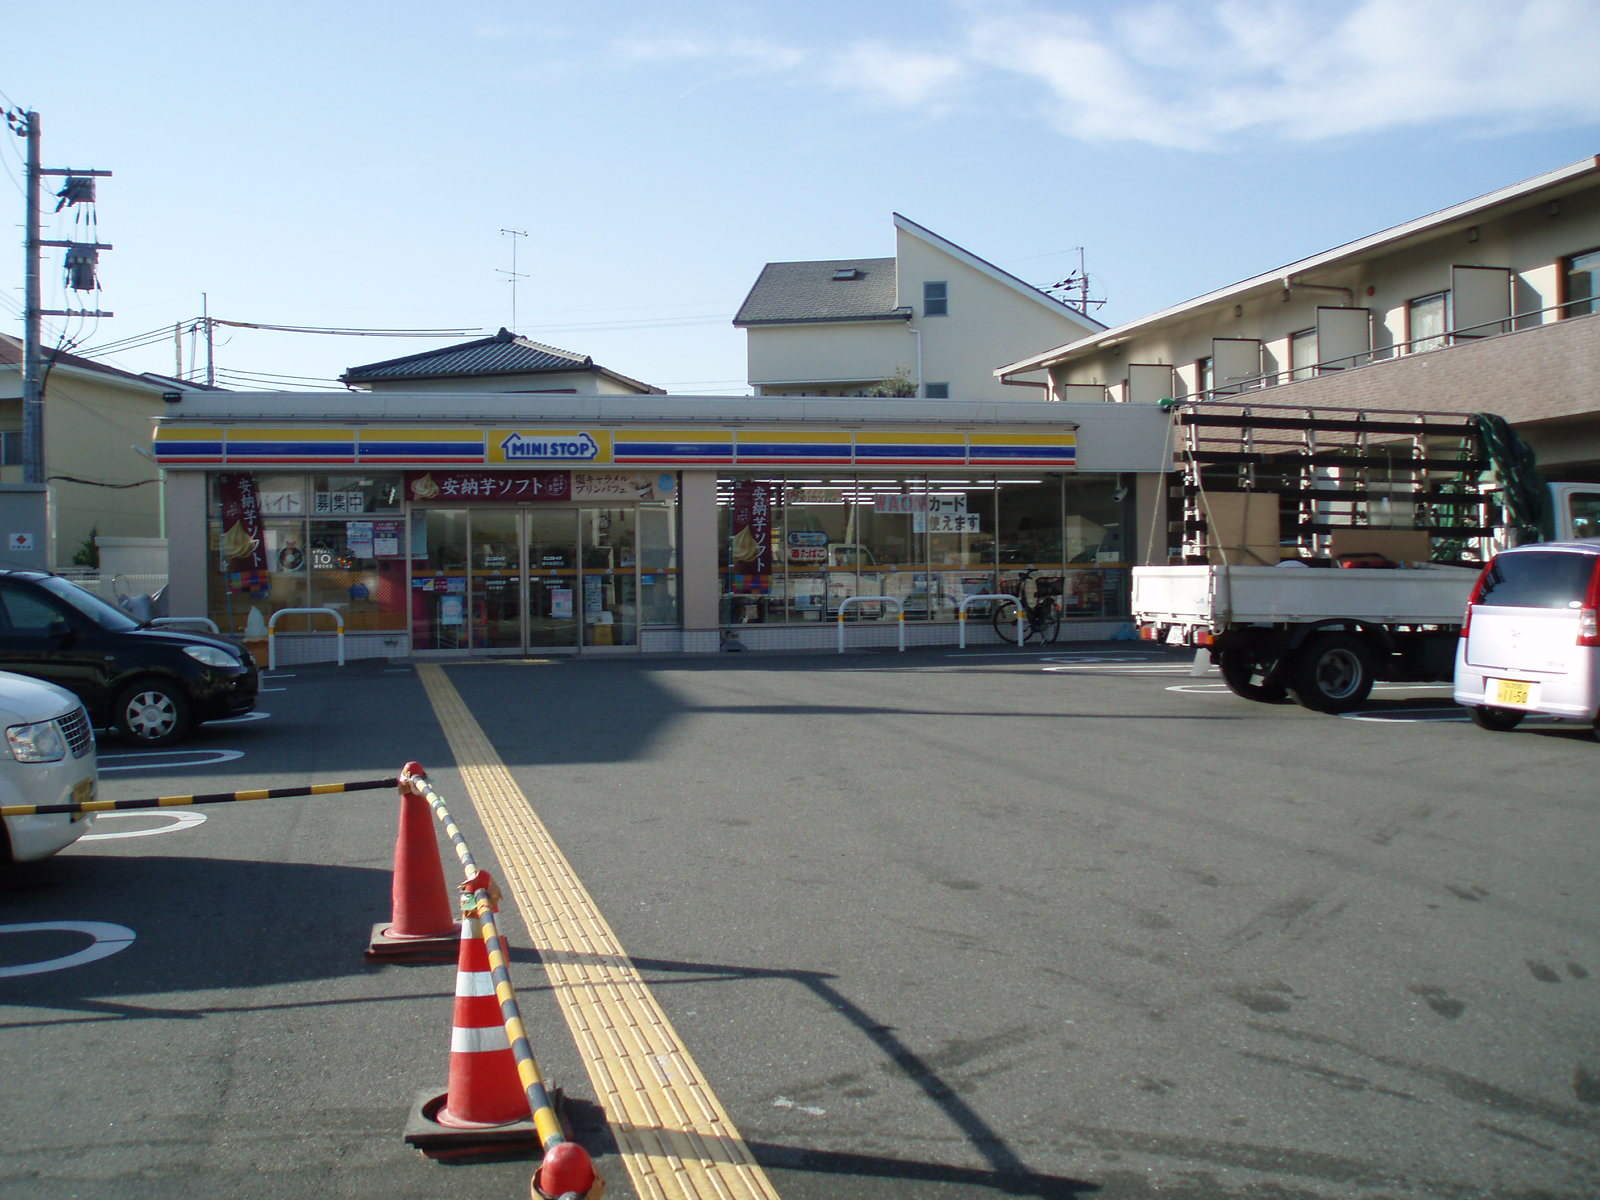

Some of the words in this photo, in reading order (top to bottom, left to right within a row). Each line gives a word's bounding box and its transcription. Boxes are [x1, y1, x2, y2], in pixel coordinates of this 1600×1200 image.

[512, 443, 547, 455] MINI
[550, 443, 589, 455] STOP
[442, 477, 542, 495] 安納芋ソフト
[317, 494, 362, 512] 募集中
[929, 497, 965, 512] カード
[238, 479, 262, 568] 安納芋ソフト
[752, 486, 767, 572] 安納芋ソフト
[929, 515, 979, 531] 使えます
[314, 554, 331, 564] 10
